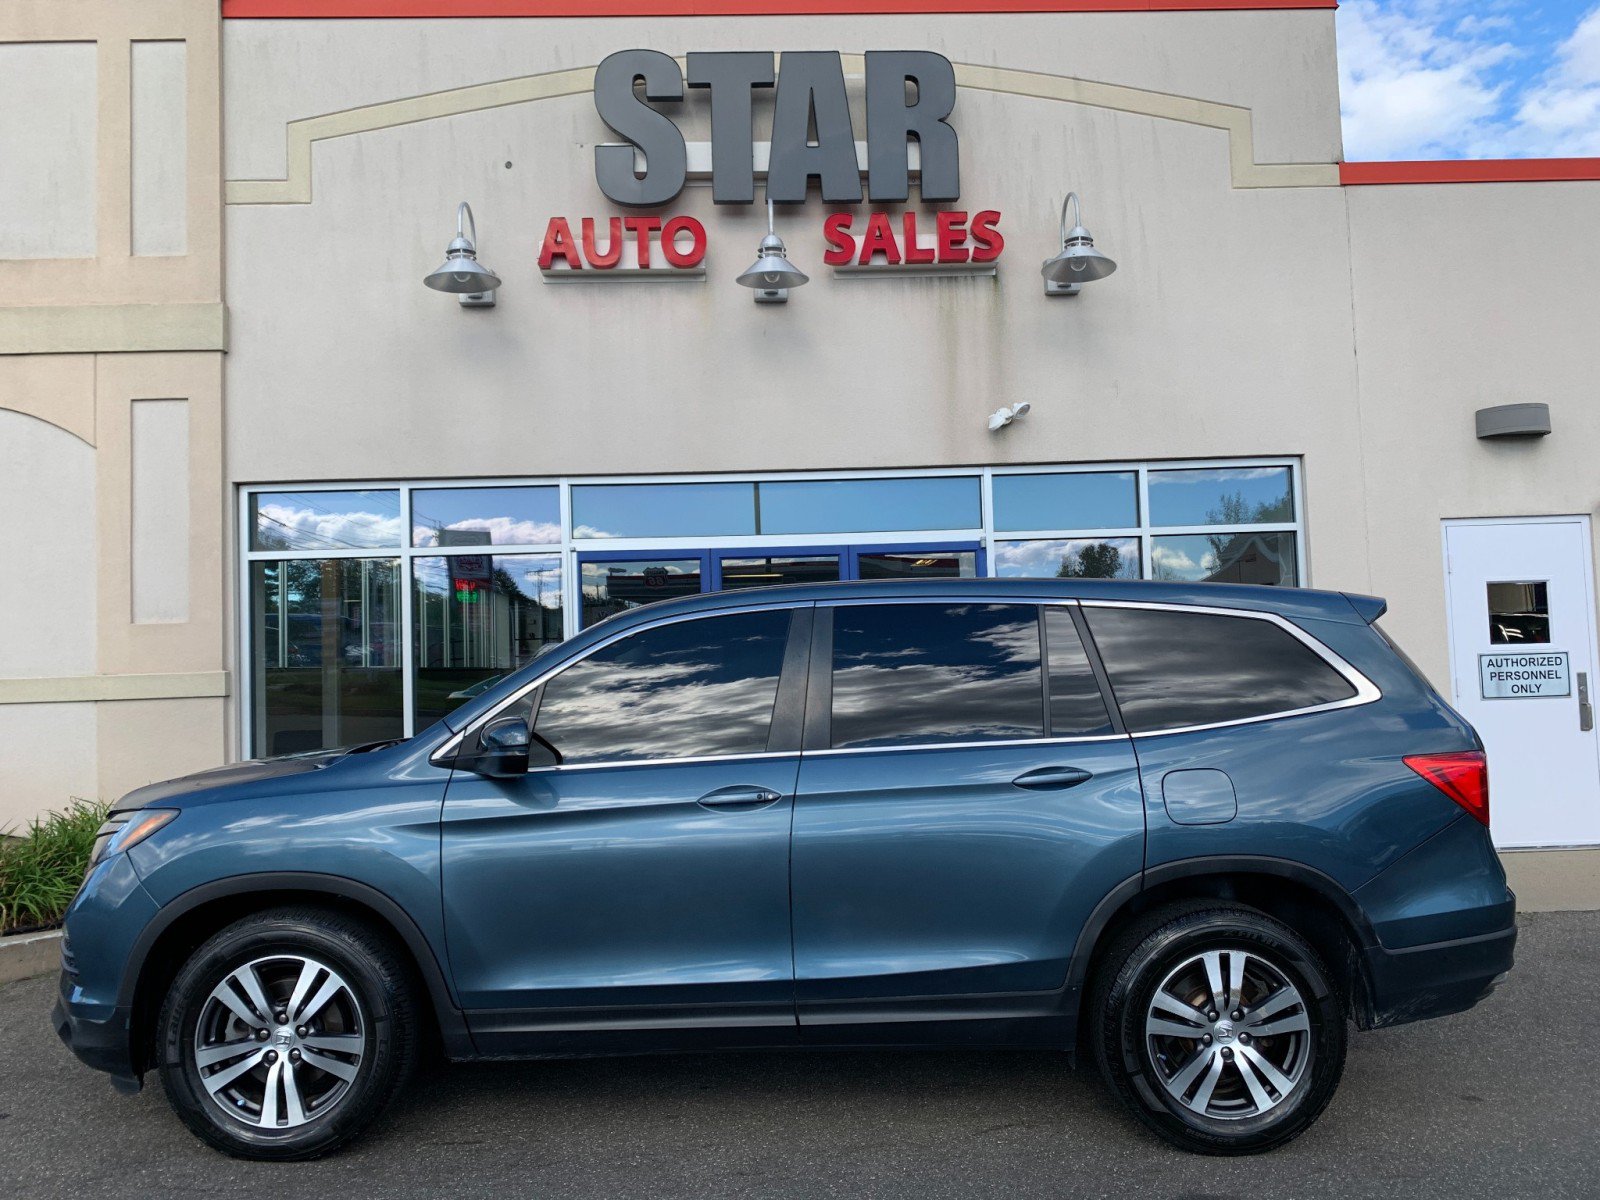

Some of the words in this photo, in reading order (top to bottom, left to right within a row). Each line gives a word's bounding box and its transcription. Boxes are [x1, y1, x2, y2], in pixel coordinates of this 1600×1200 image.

[594, 49, 960, 205] STAR
[538, 216, 708, 270] AUTO
[824, 210, 1005, 265] SALES
[1487, 656, 1563, 668] AUTHORIZED
[1490, 670, 1562, 681] PERSONNEL
[1511, 684, 1542, 694] ONLY
